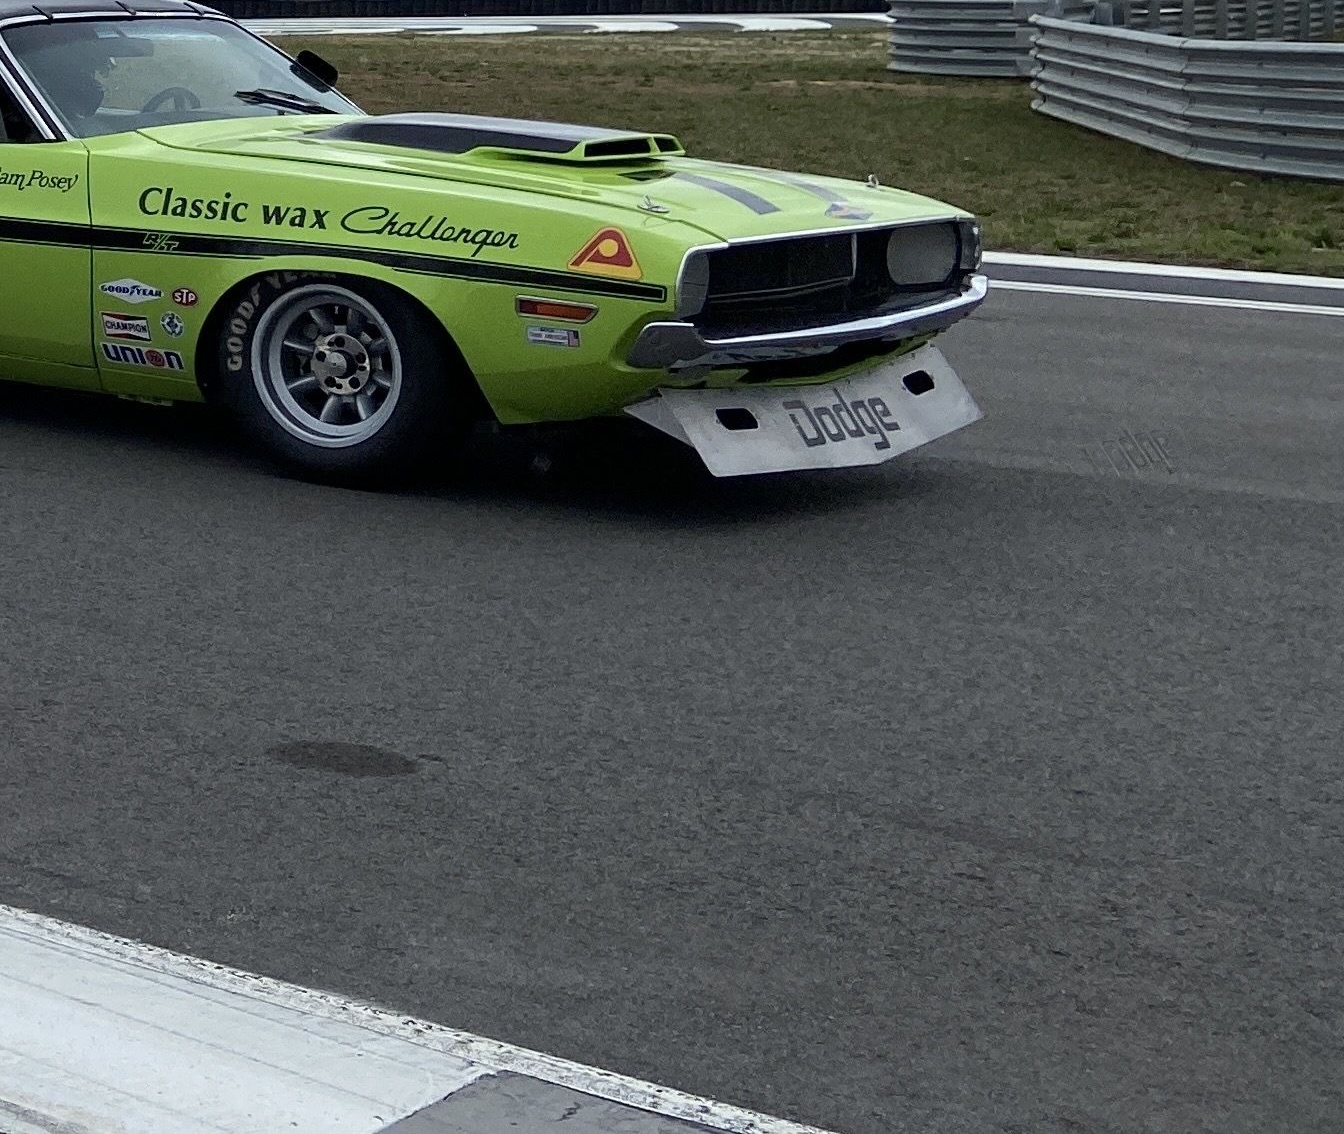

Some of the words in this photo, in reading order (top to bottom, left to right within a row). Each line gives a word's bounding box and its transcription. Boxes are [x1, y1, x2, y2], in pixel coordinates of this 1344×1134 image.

[25, 169, 79, 193] Posey
[138, 186, 248, 223] Classic
[262, 204, 331, 231] wax
[340, 206, 520, 257] Challenger
[100, 284, 162, 298] GOODYEAR
[174, 289, 196, 304] STP
[105, 320, 148, 333] CHAMPION
[782, 387, 901, 450] Dodge
